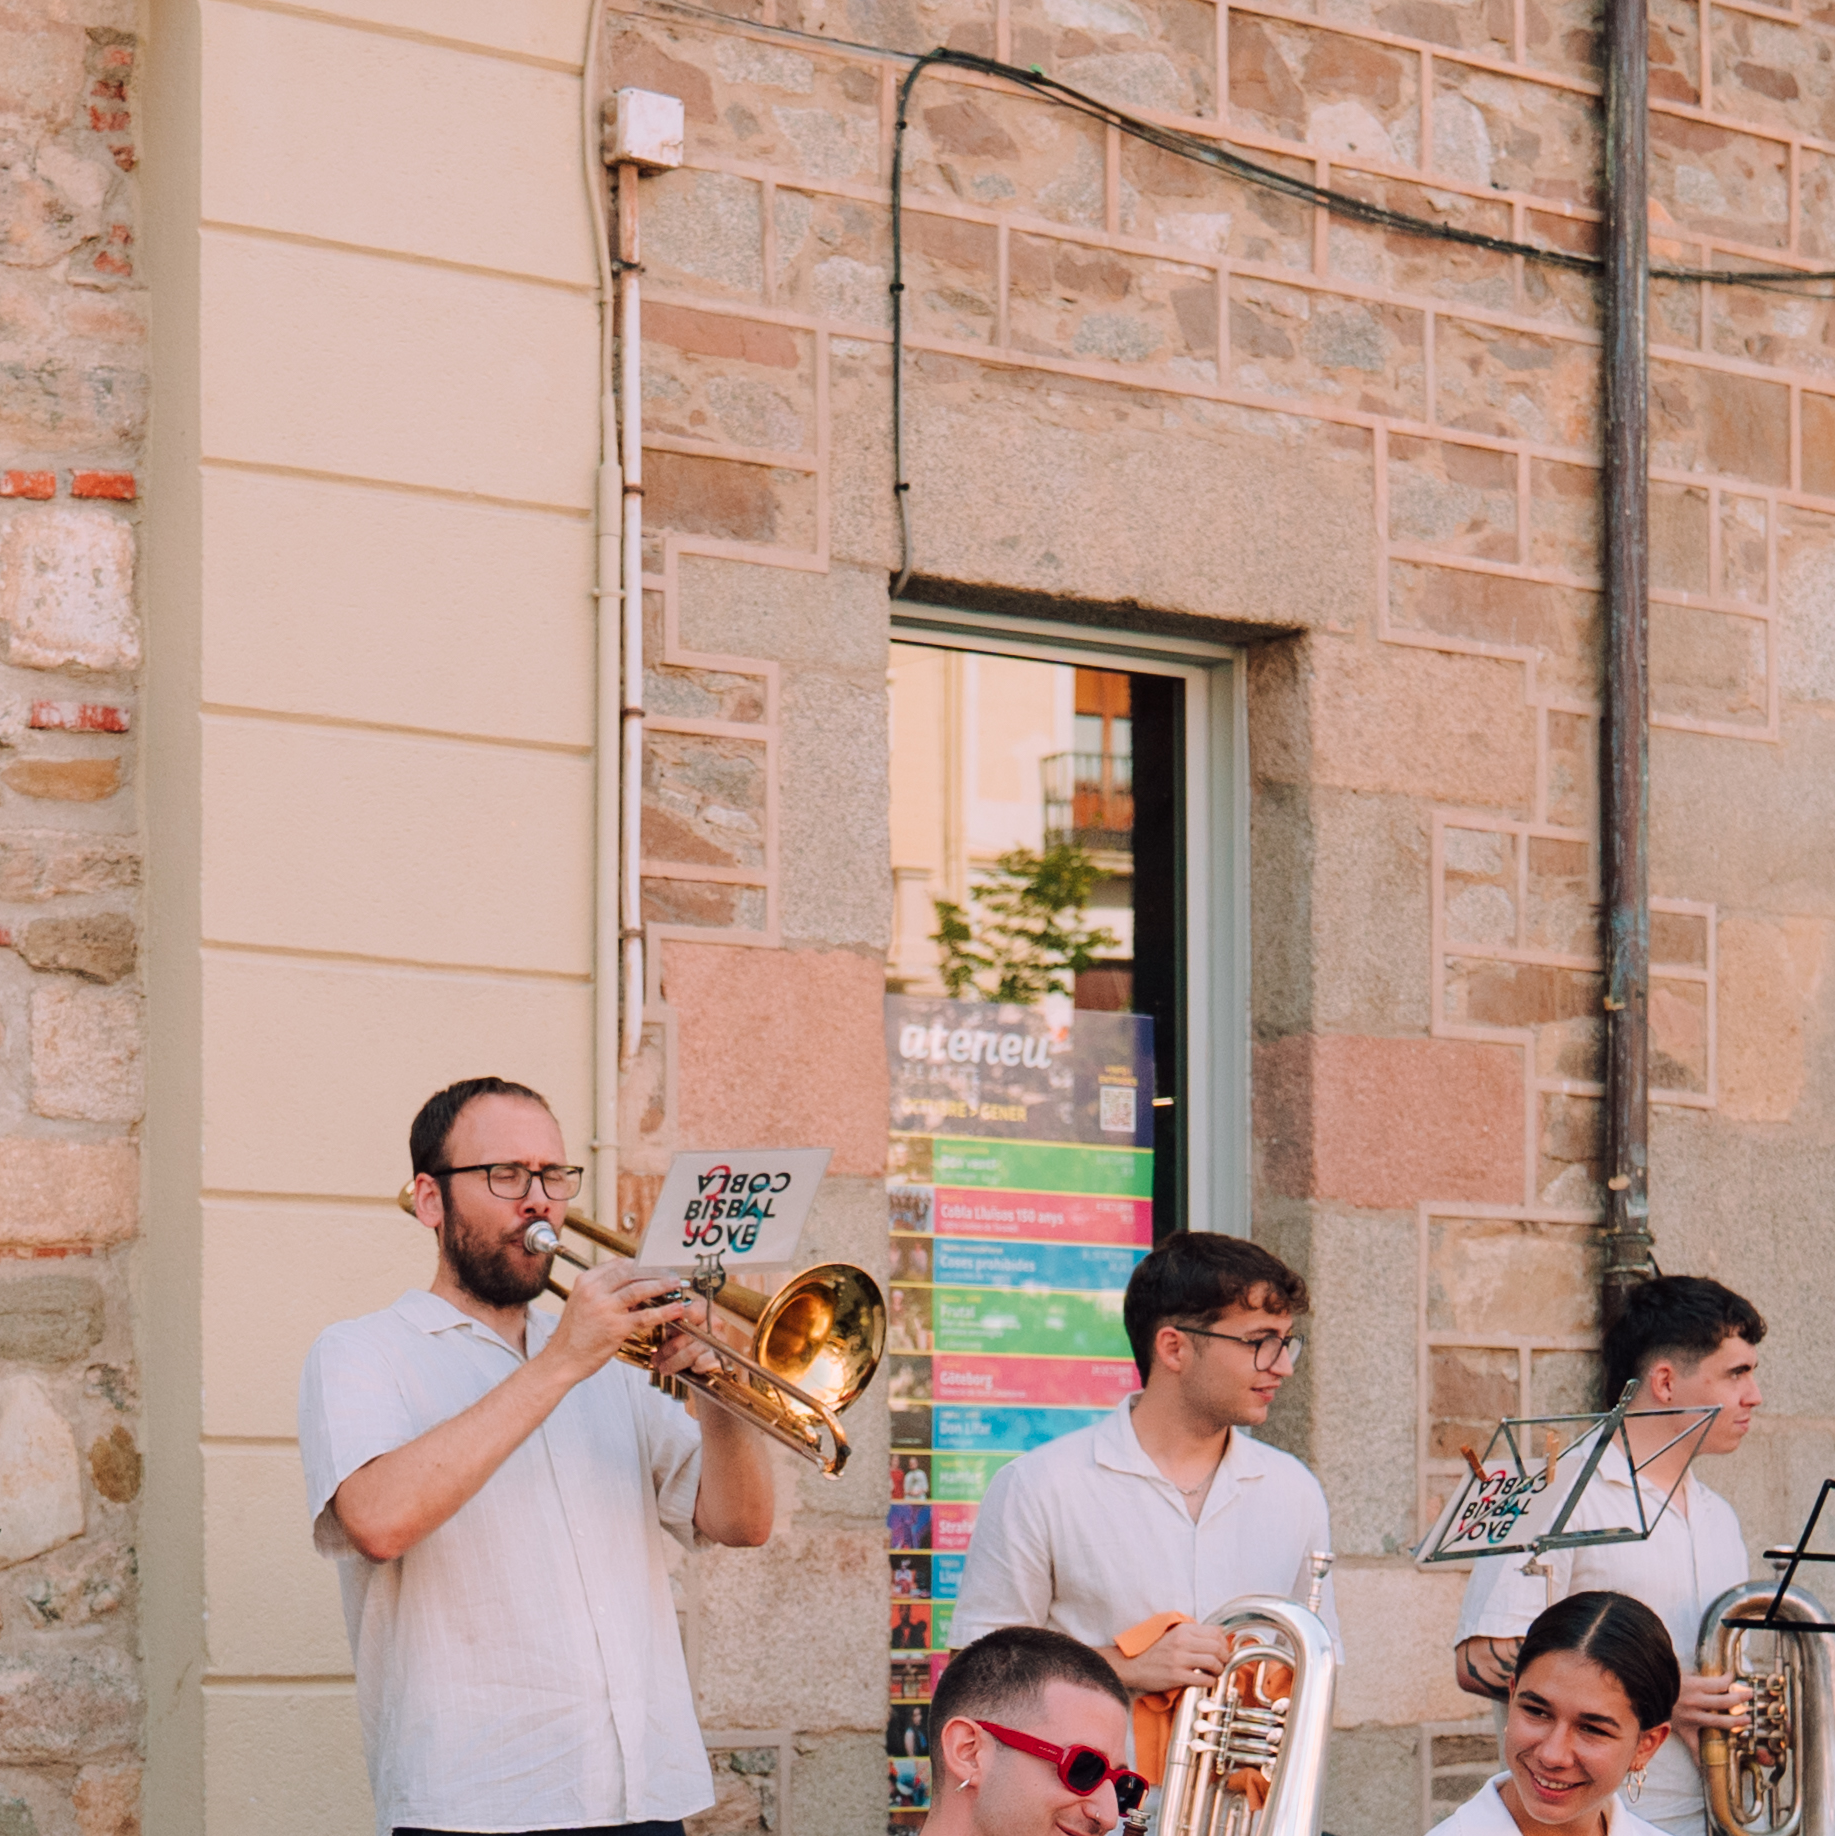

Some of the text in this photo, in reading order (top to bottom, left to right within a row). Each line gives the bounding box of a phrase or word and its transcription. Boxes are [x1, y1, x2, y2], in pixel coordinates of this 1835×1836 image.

[899, 1023, 1051, 1069] ateneu
[980, 1102, 1028, 1122] GENER
[683, 1198, 776, 1220] BISBAL
[941, 1204, 973, 1219] Cobla
[1038, 1211, 1064, 1228] anys
[682, 1224, 758, 1248] JOVE
